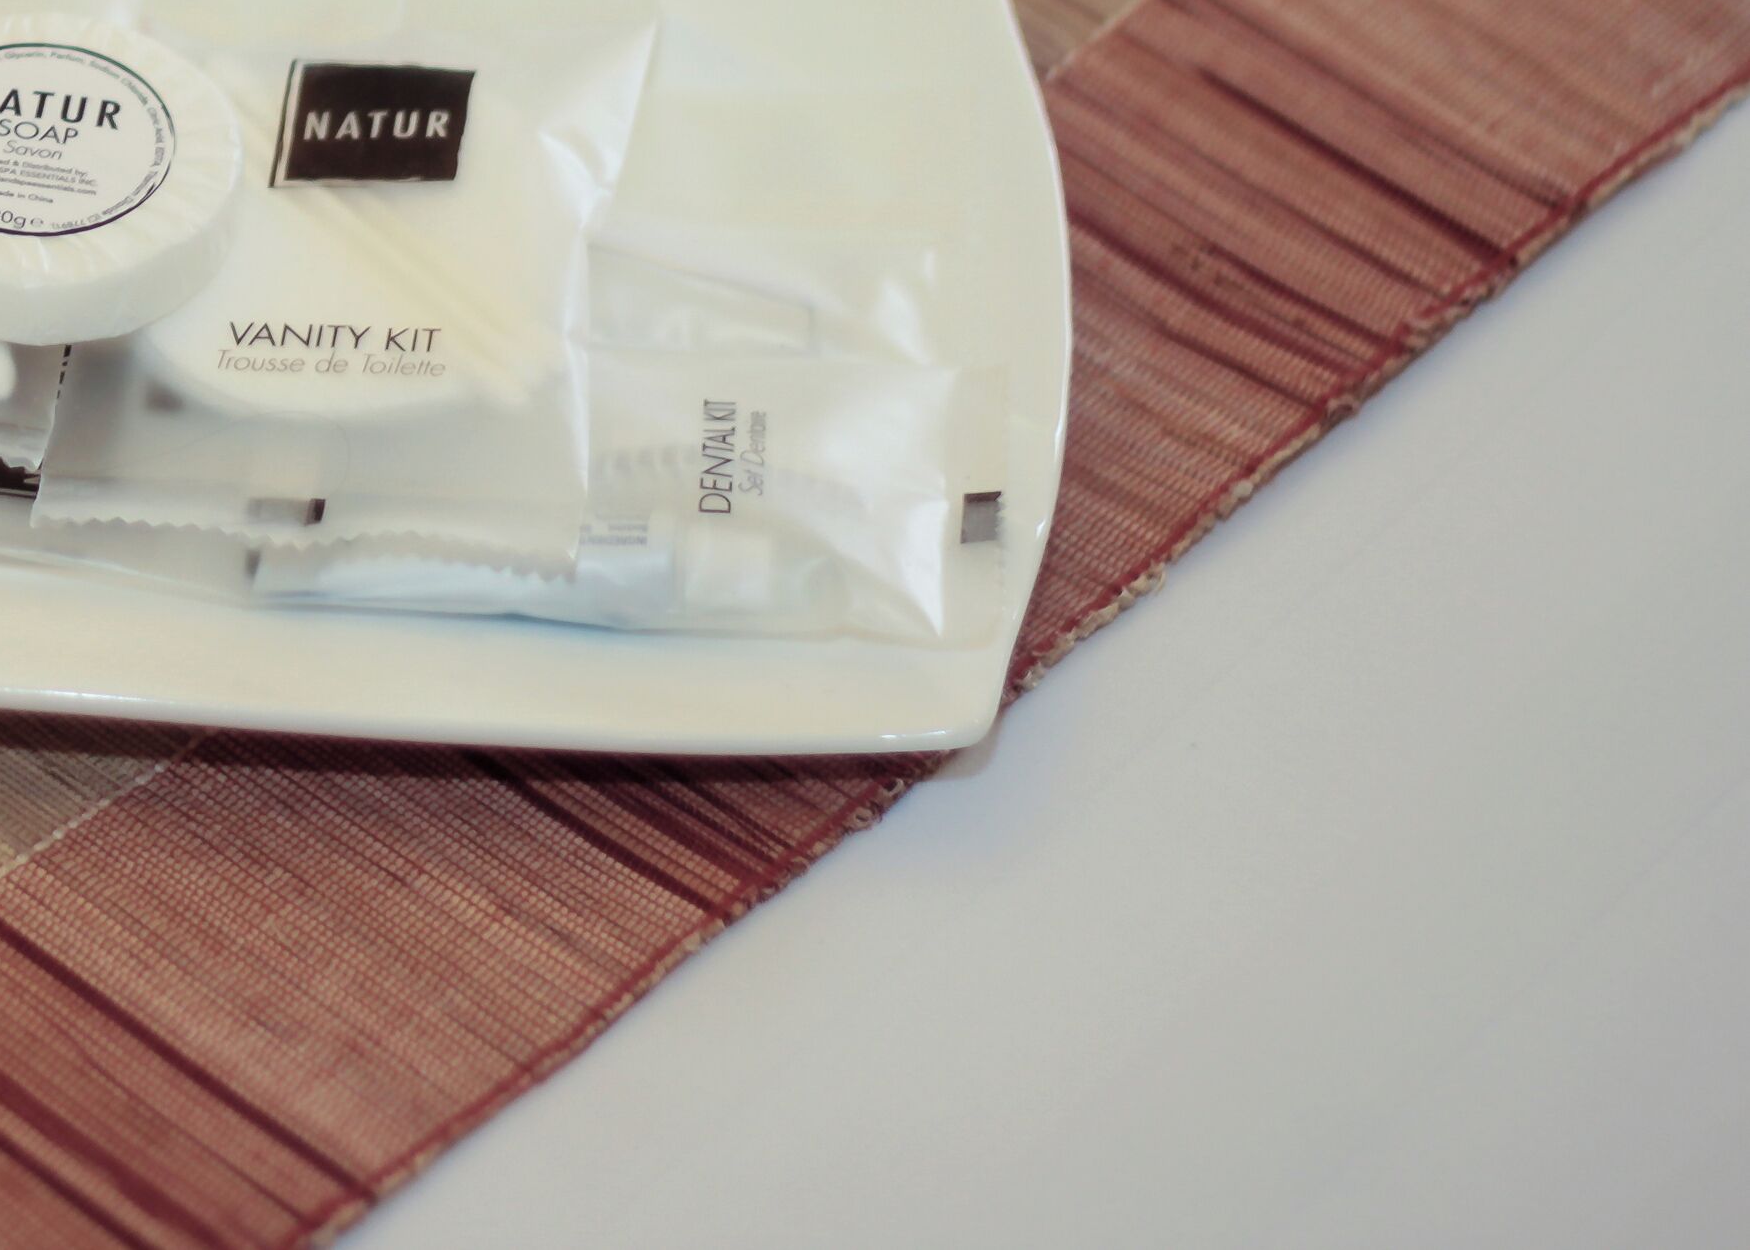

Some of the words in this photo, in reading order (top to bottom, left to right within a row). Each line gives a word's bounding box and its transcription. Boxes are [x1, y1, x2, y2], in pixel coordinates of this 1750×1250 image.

[303, 110, 450, 140] NATUR
[2, 139, 62, 160] Savon
[229, 321, 371, 349] VANITY
[384, 327, 441, 352] KIT
[217, 349, 306, 373] Trousse
[315, 351, 348, 375] de
[362, 353, 446, 377] Toilette
[703, 399, 736, 421] KIT
[698, 427, 735, 513] DENTAL
[738, 470, 764, 496] Set
